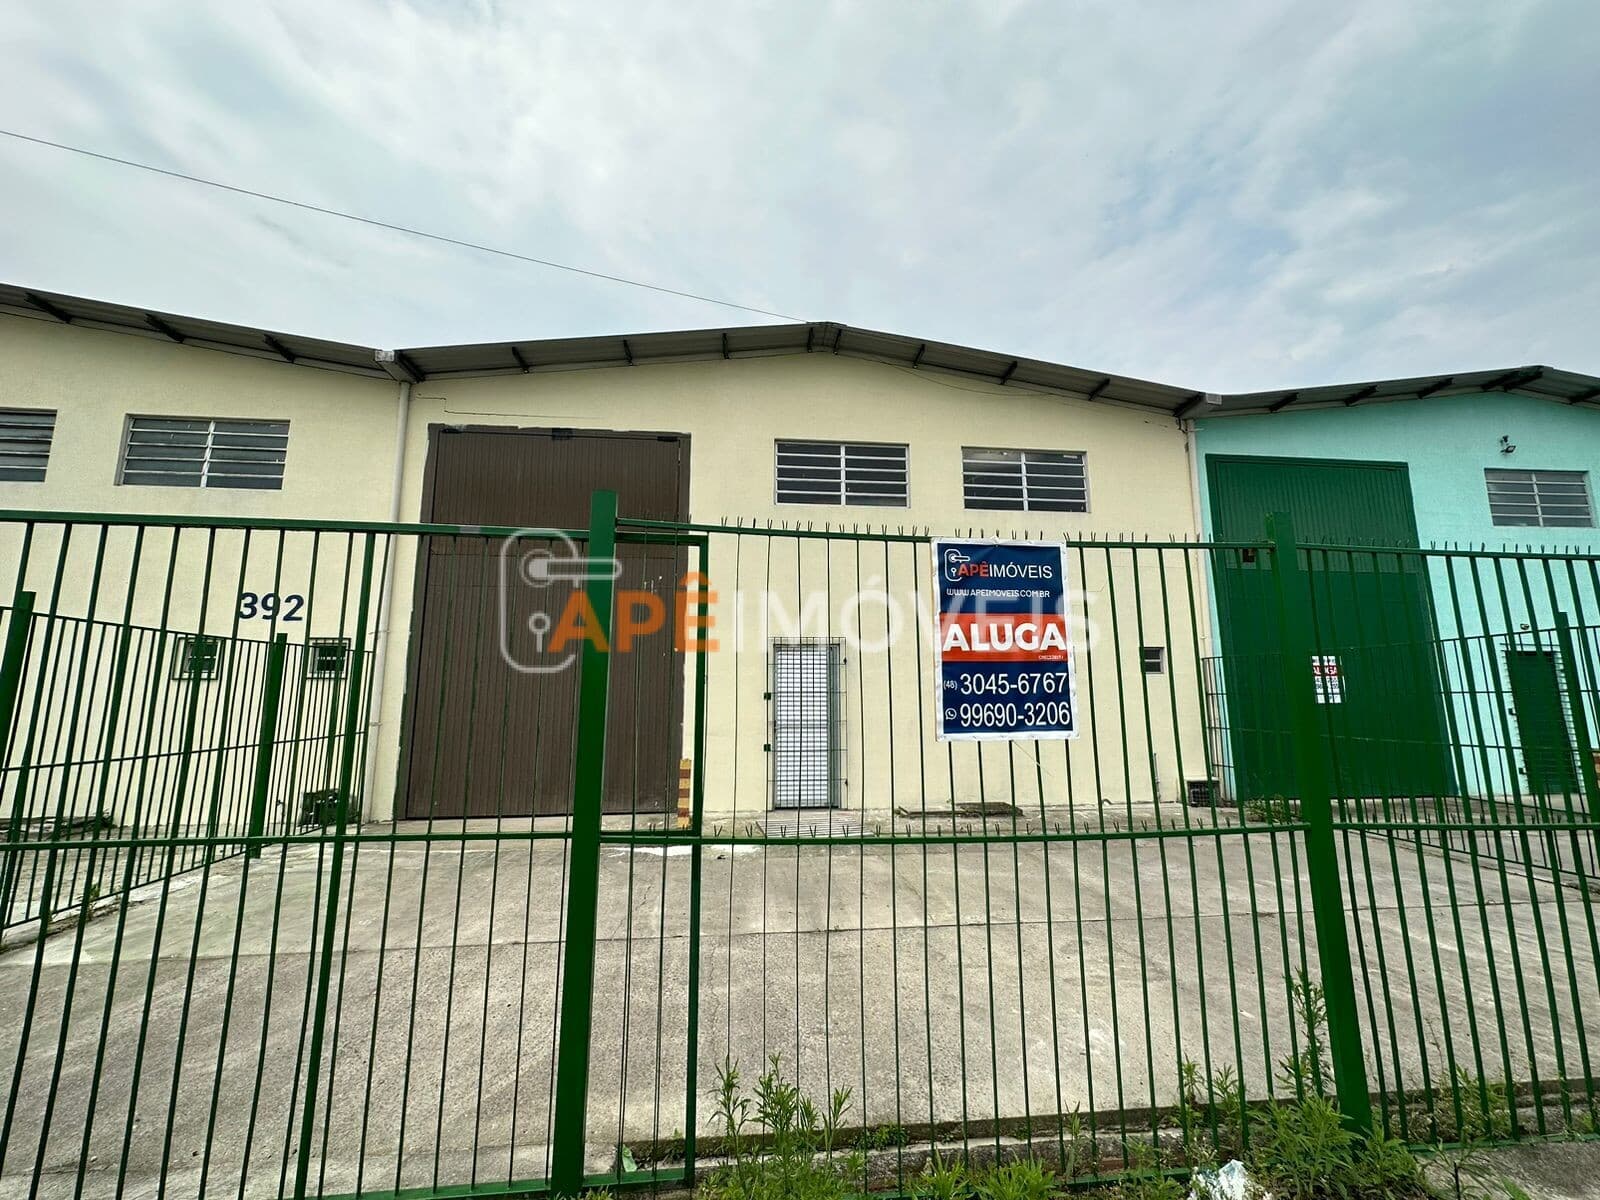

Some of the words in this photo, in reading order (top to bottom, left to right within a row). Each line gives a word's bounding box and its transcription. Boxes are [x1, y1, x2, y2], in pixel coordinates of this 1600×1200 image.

[239, 592, 304, 621] 392
[943, 623, 1067, 651] ALUGA
[960, 673, 1067, 694] 3045-6767
[960, 702, 1070, 726] 99690-3206
